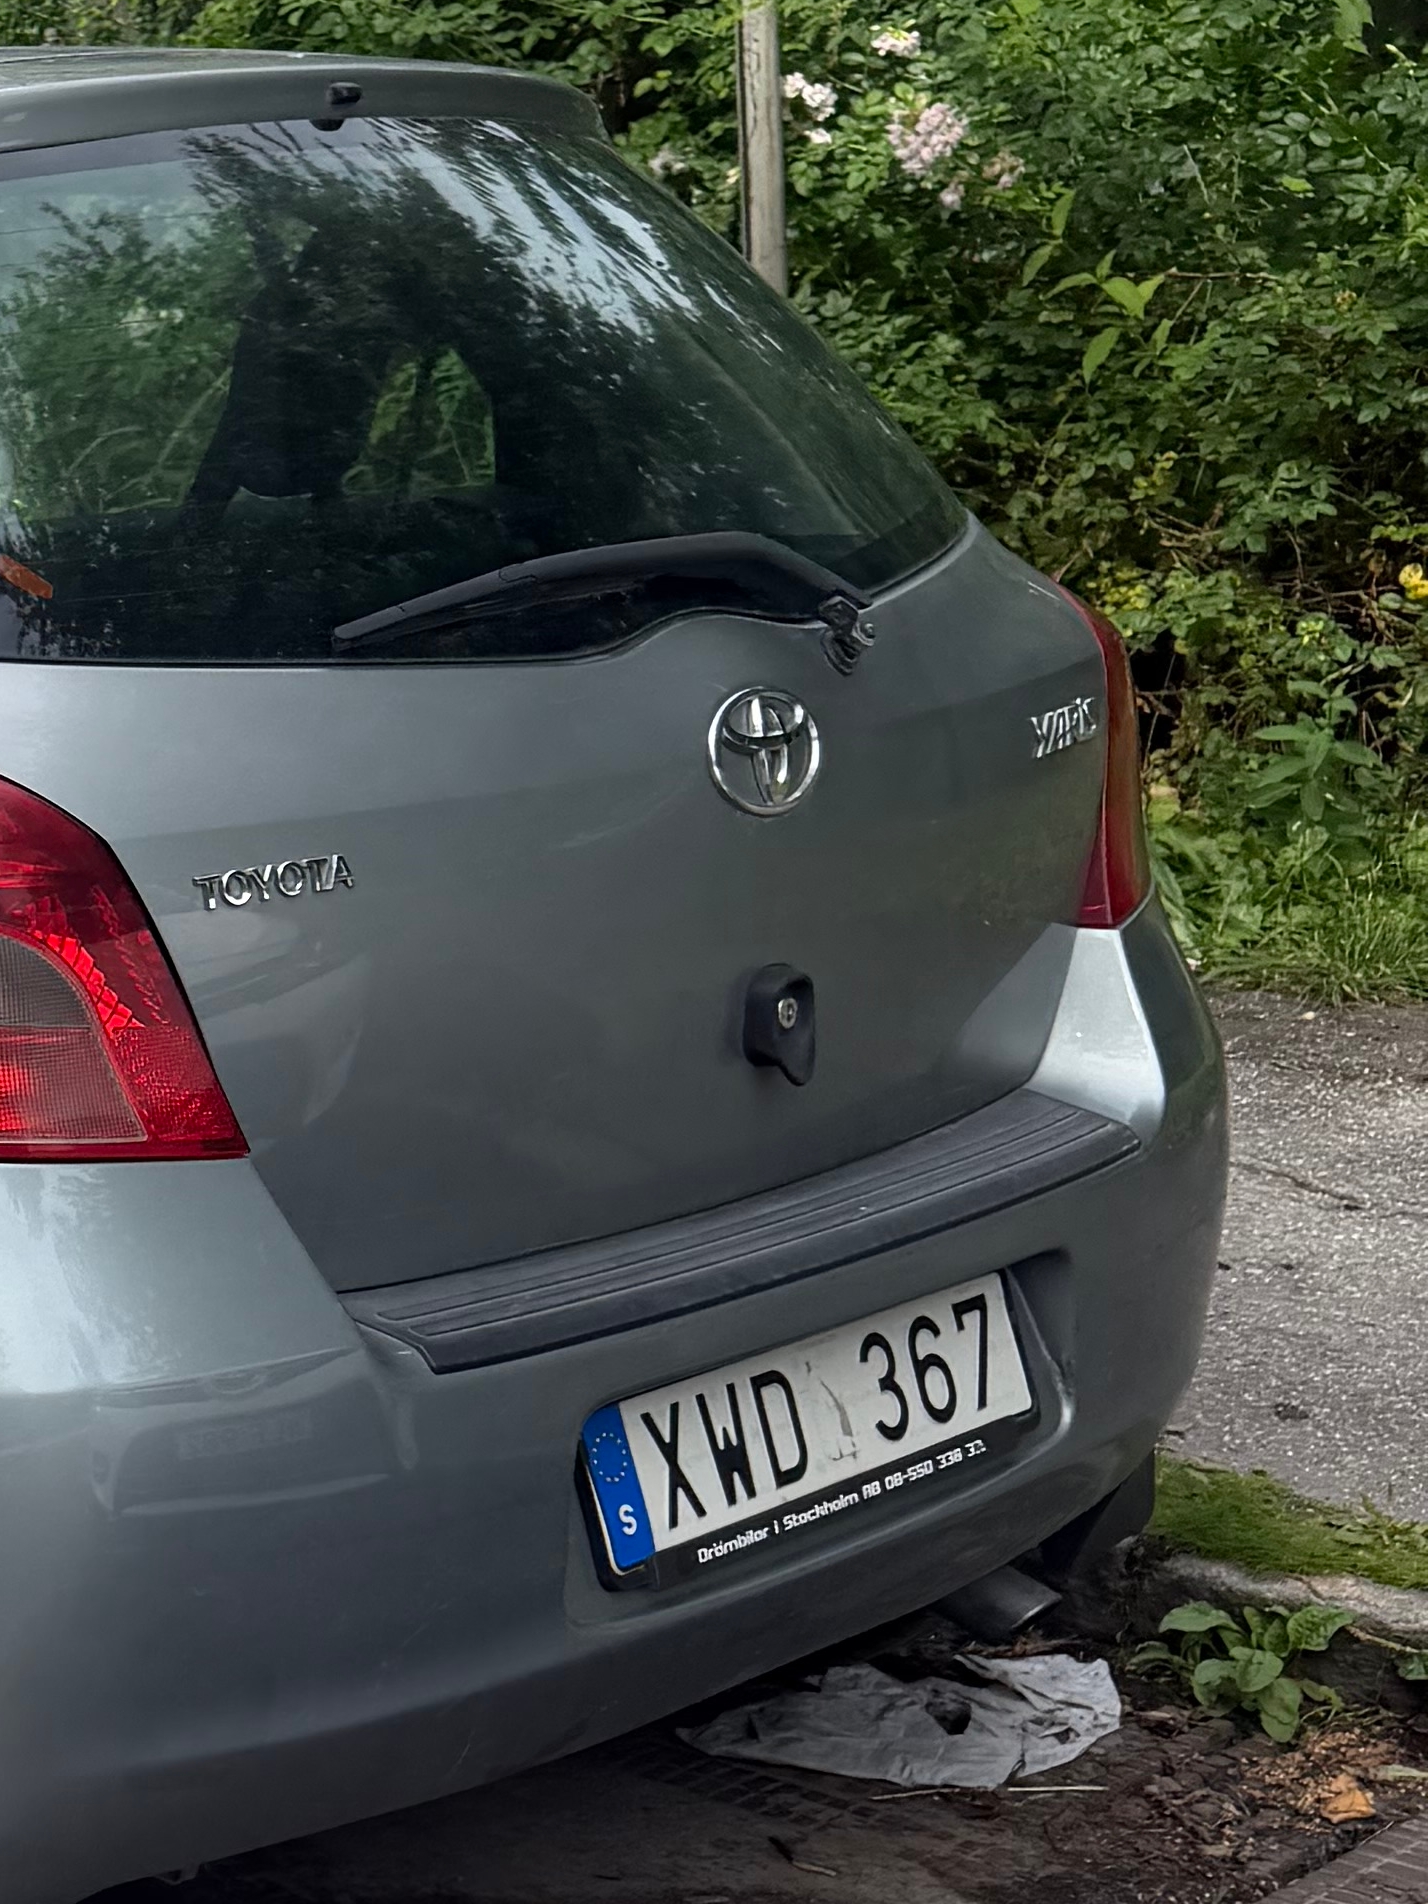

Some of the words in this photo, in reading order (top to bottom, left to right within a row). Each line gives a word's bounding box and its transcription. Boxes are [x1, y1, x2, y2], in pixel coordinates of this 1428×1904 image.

[193, 853, 355, 911] TOYOTA
[618, 1503, 638, 1536] S
[640, 1368, 809, 1530] XWD
[859, 1293, 988, 1442] 367
[782, 1492, 860, 1531] Stockholm
[861, 1480, 882, 1500] AB
[884, 1459, 934, 1491] 08-550
